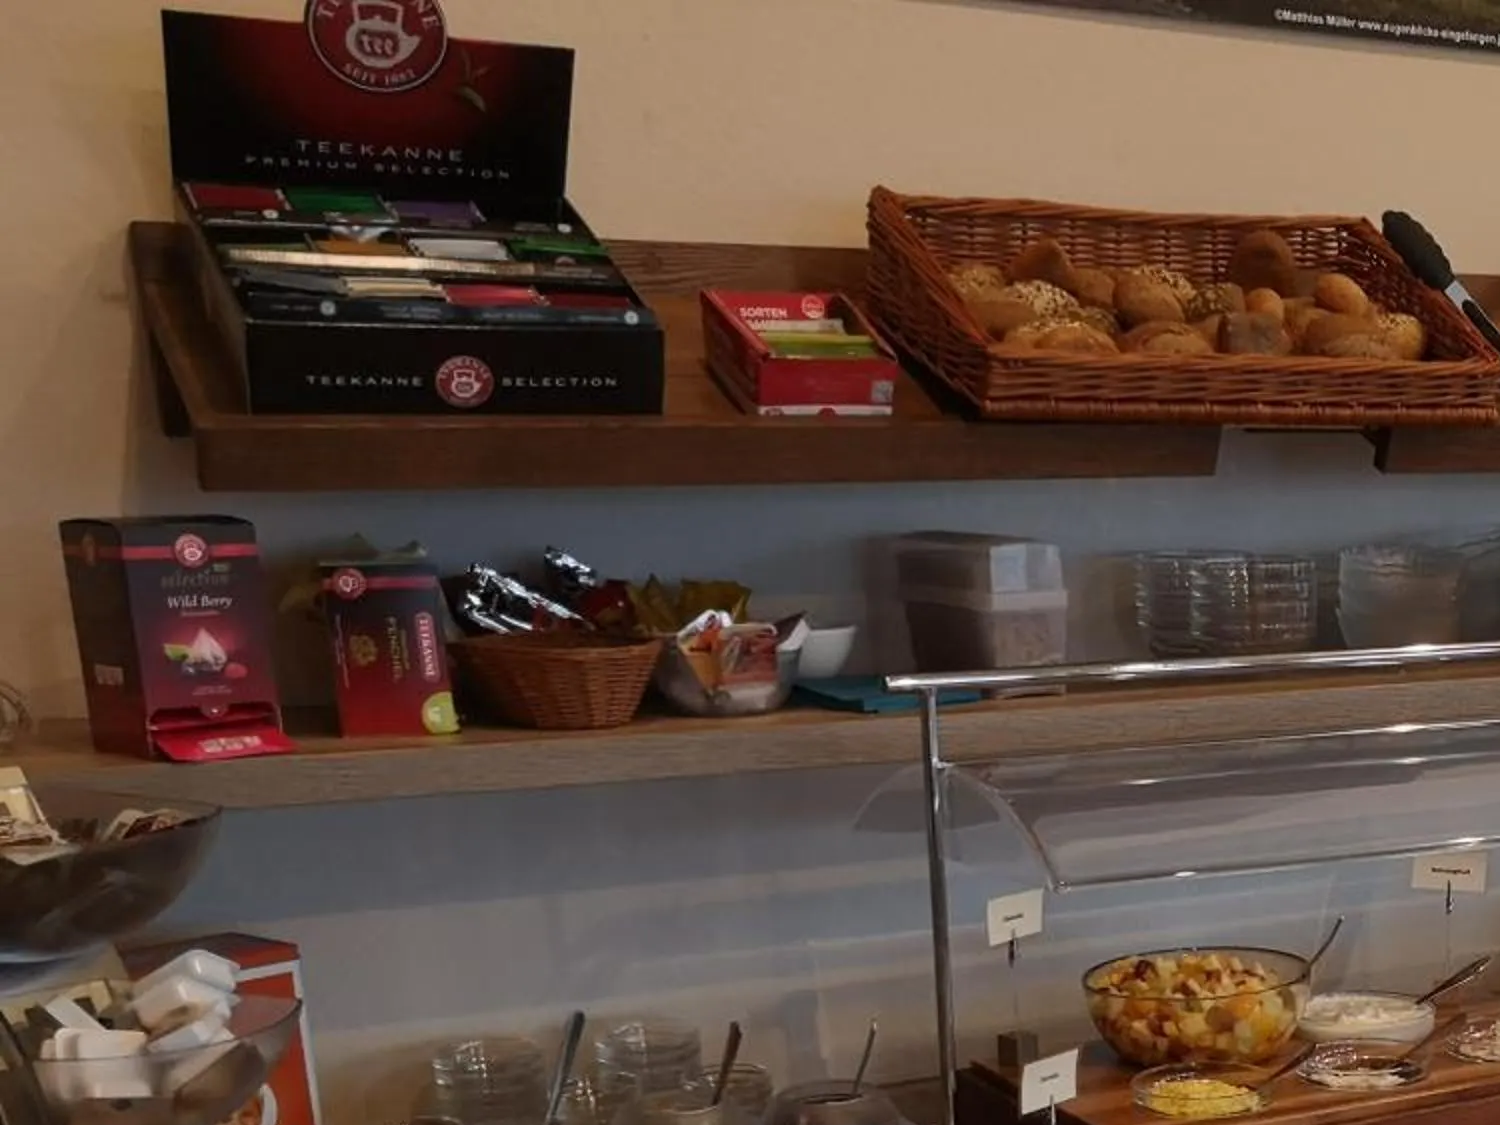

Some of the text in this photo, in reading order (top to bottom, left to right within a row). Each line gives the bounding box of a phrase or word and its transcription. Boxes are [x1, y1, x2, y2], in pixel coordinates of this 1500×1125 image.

[296, 139, 464, 163] TEEKANNE
[244, 156, 511, 179] PREMIUM SELECTION
[306, 375, 619, 388] TEEKANNE SELECTION
[167, 594, 233, 609] Wild Berry
